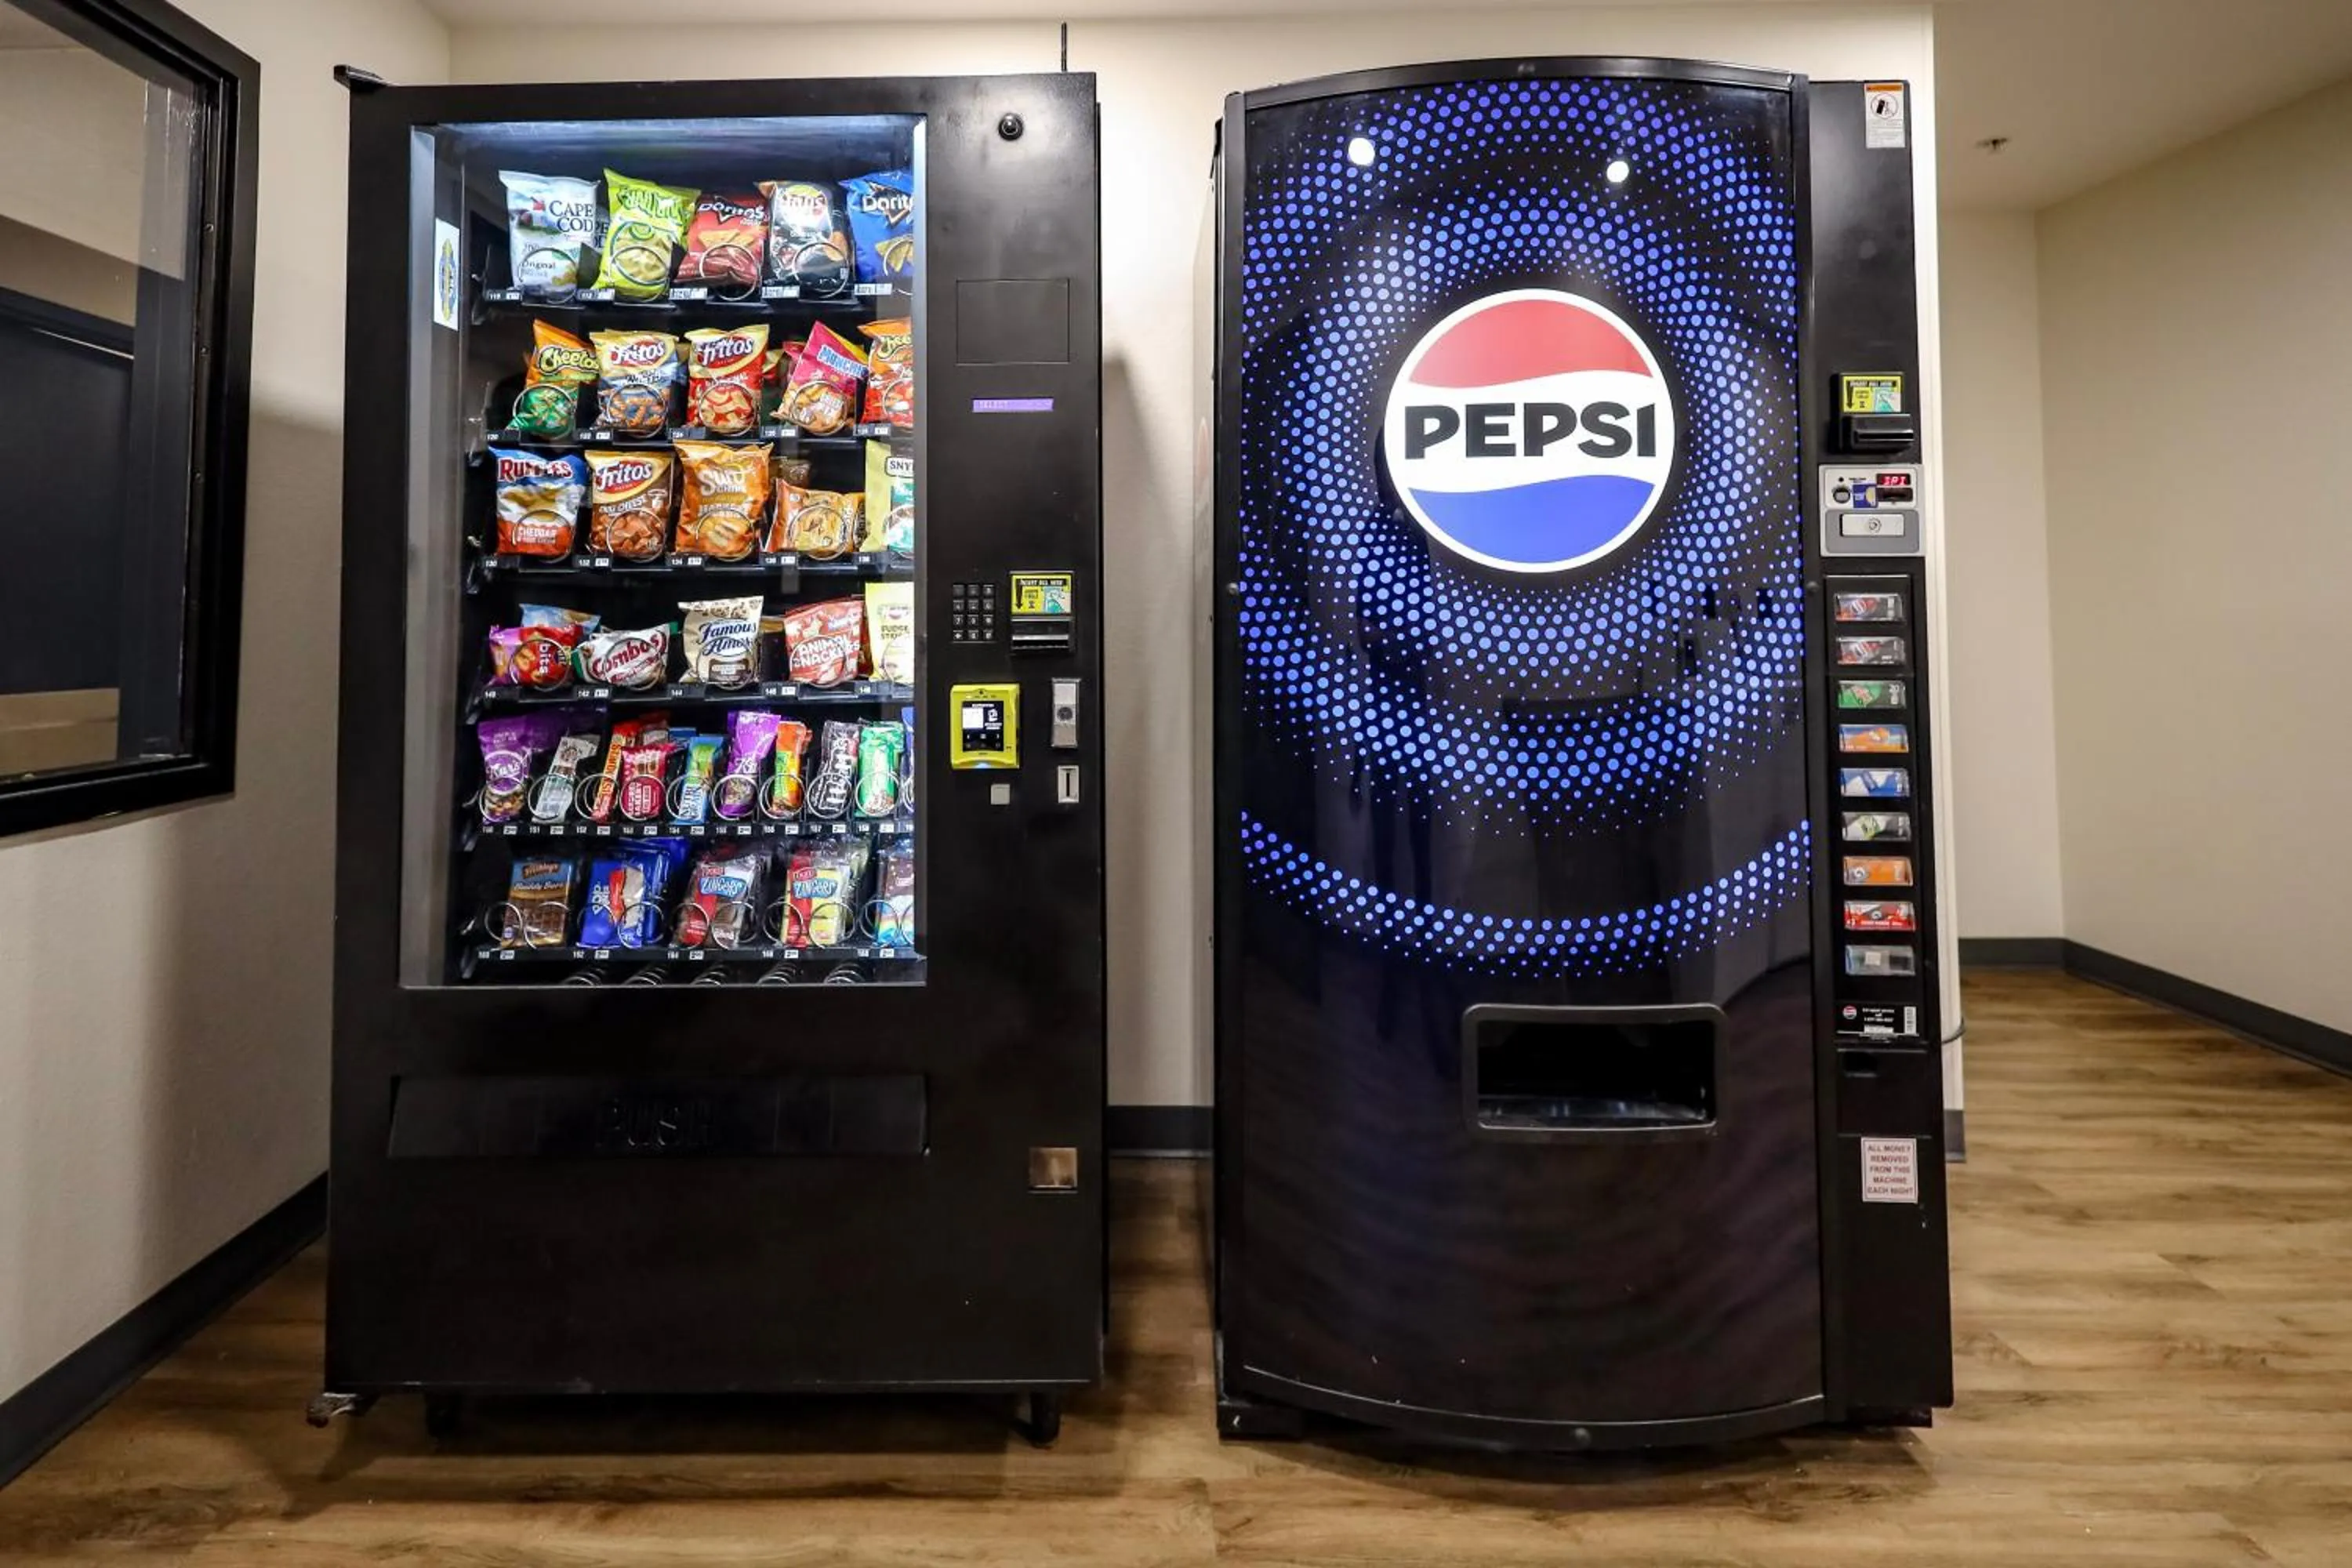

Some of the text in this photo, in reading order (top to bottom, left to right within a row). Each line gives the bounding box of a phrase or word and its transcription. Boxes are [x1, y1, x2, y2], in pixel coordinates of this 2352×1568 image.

[549, 201, 594, 216] CAPE
[862, 195, 913, 212] Dorit
[557, 217, 594, 233] COD
[877, 335, 912, 359] Chee
[539, 346, 600, 374] Cheetos
[1404, 401, 1657, 460] PEPSI
[596, 460, 652, 489] Fritos
[699, 621, 756, 644] Famous
[539, 642, 550, 674] bits
[590, 632, 660, 678] Combos
[703, 638, 753, 656] Amos
